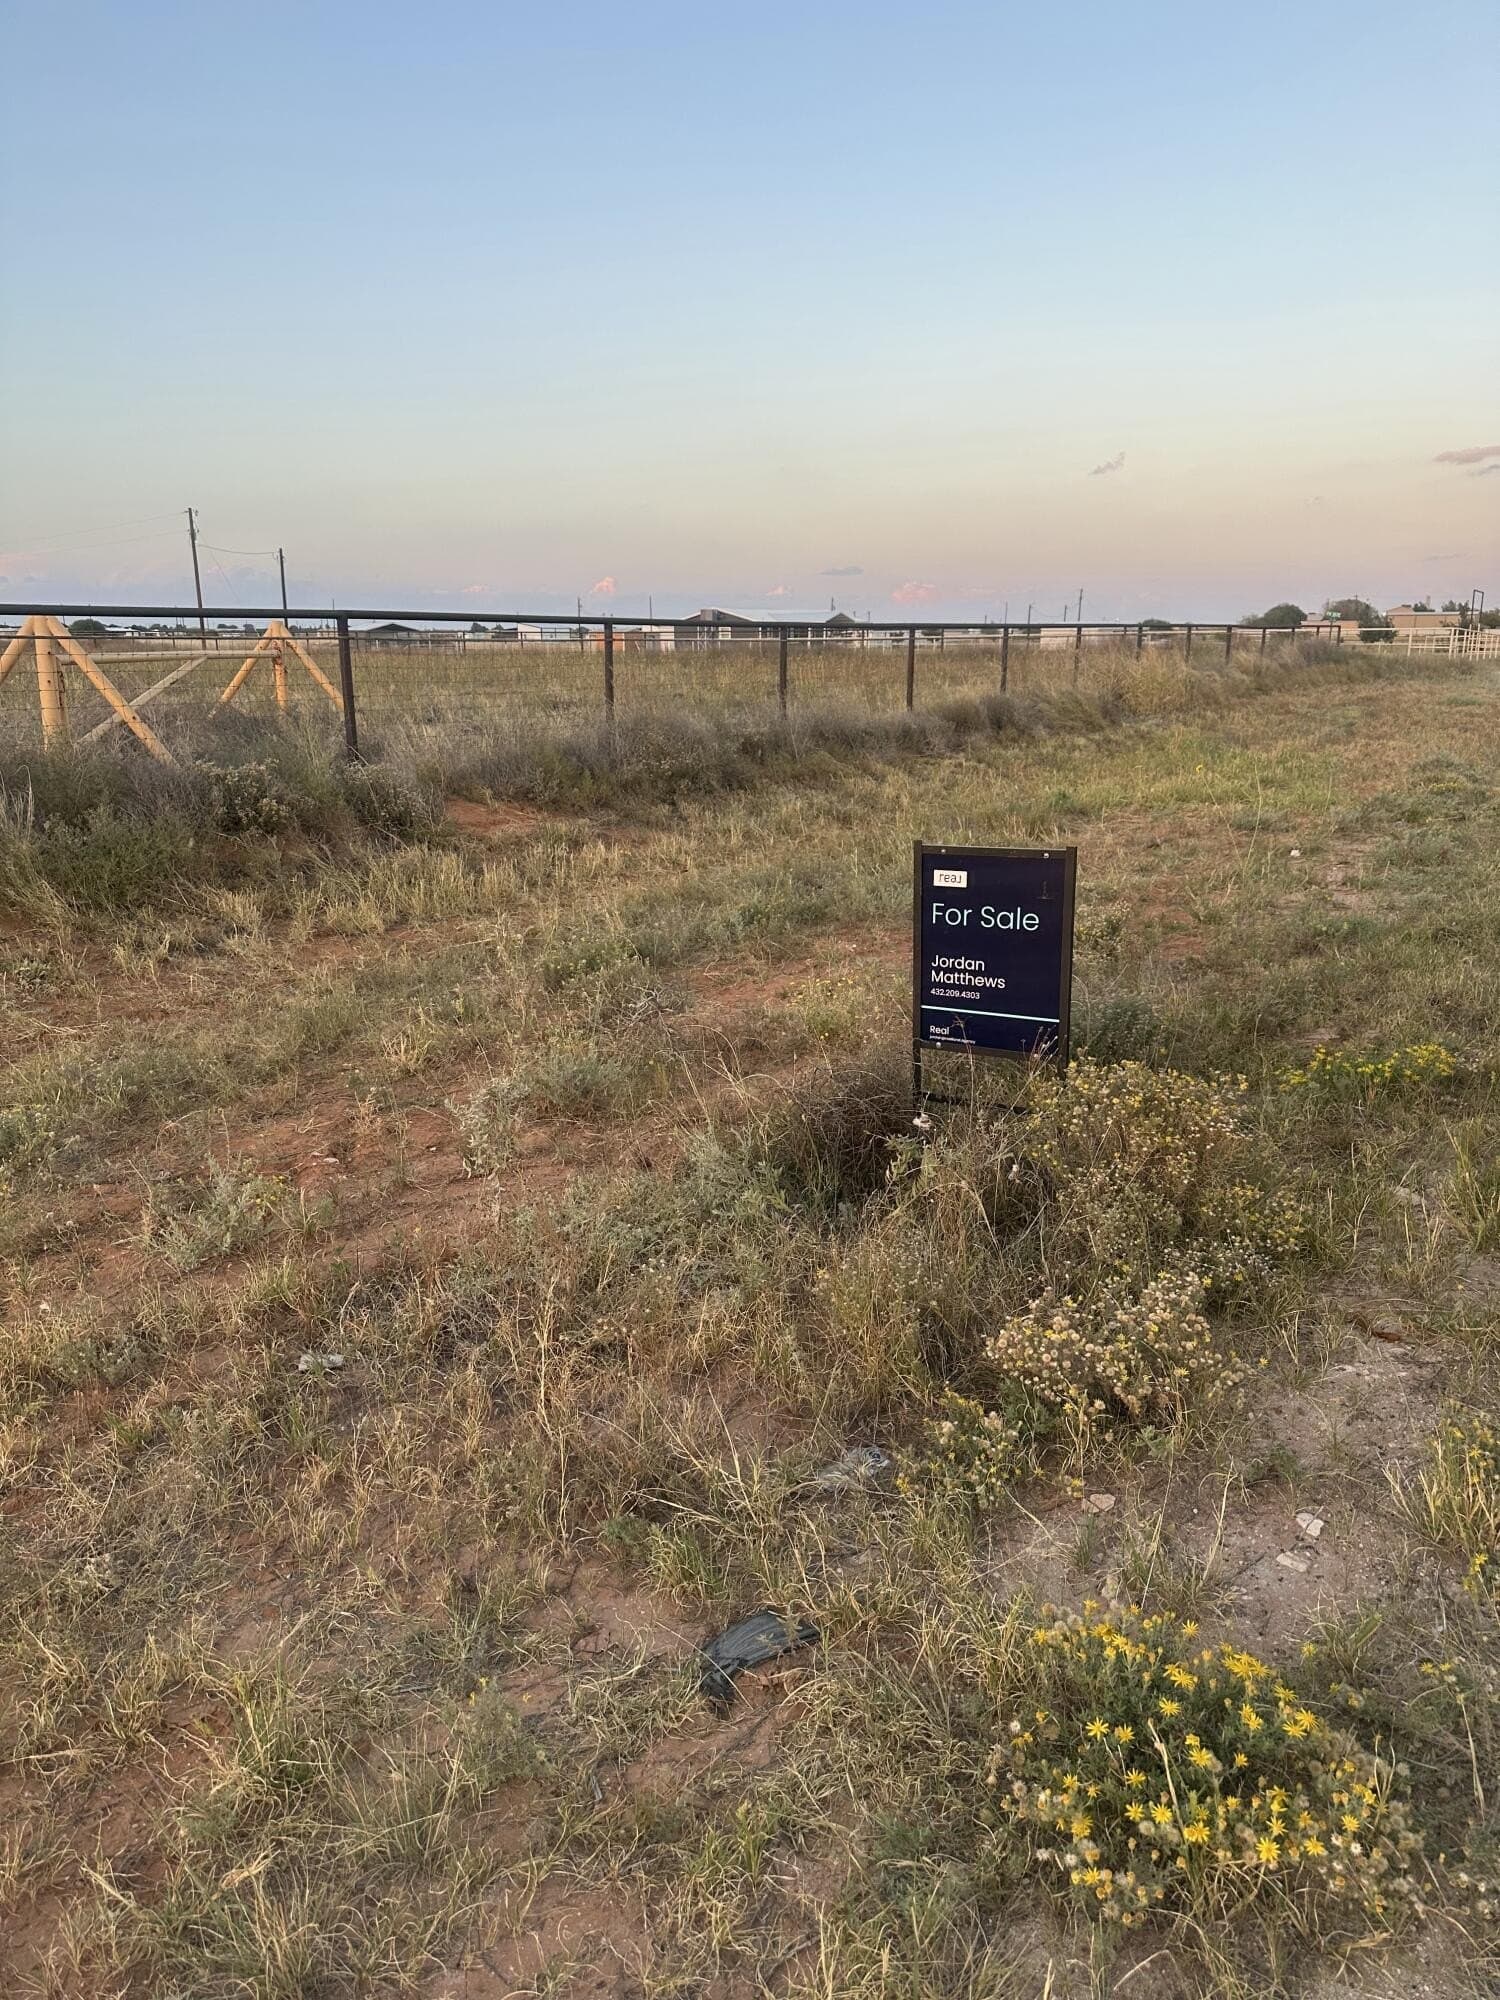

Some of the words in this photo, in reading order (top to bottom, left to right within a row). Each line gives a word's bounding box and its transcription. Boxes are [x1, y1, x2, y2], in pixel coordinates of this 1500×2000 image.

[932, 902, 973, 926] For
[980, 906, 1040, 931] Sale
[931, 954, 985, 972] Jordan
[931, 970, 1006, 989] Matthews
[930, 988, 981, 1000] 432.209.4303
[929, 1025, 950, 1035] Real
